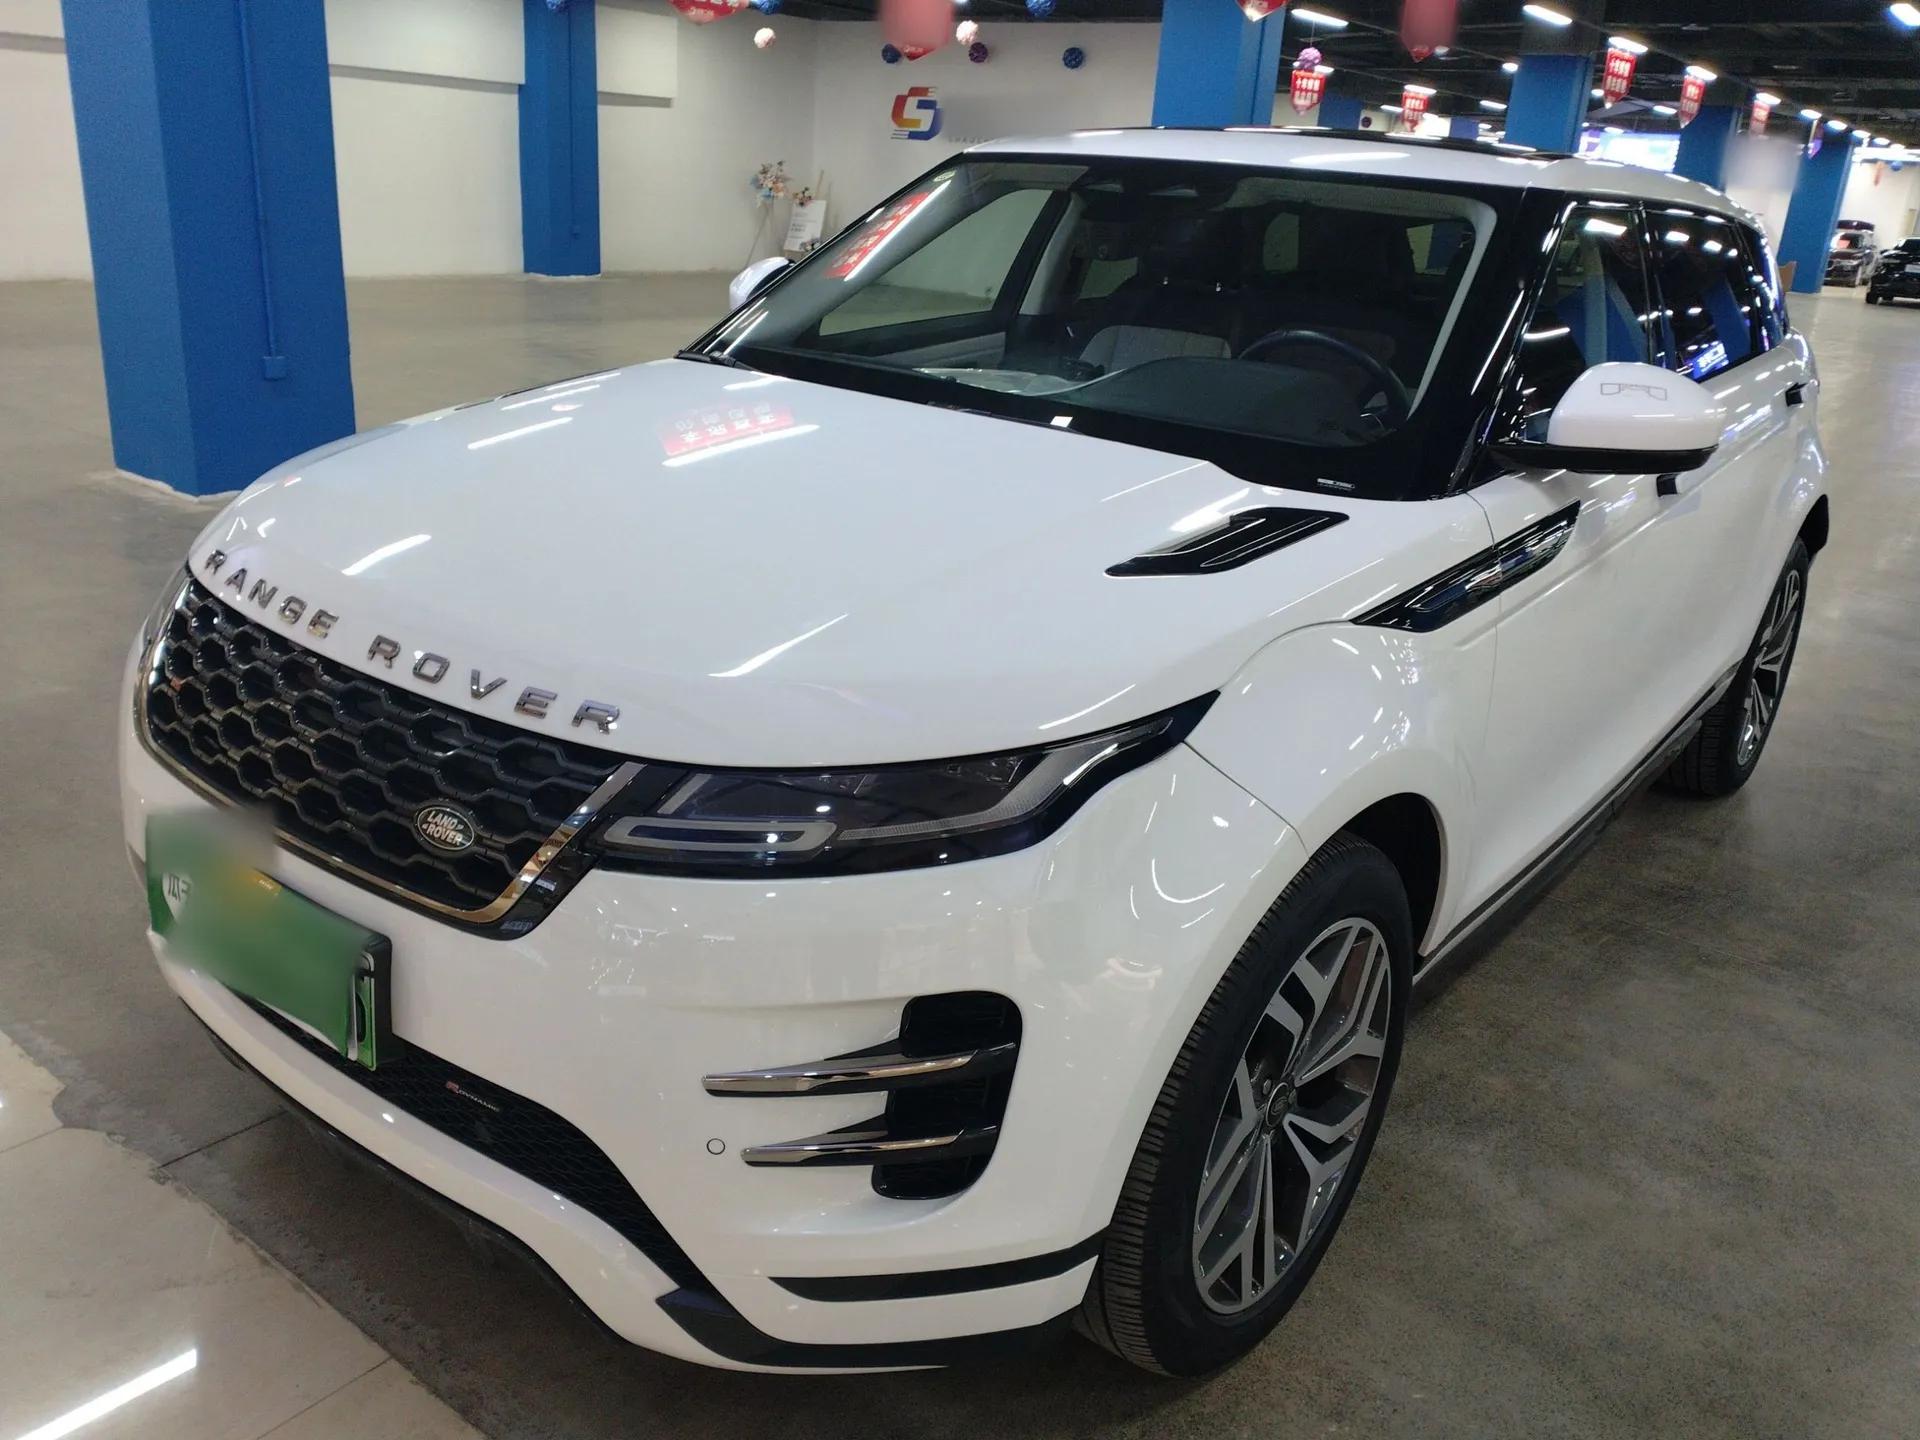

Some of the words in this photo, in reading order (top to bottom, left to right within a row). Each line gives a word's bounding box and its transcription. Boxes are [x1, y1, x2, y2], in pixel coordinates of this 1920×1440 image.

[204, 549, 339, 639] RANGE
[367, 634, 621, 735] ROVER
[427, 811, 458, 830] LAND
[426, 823, 463, 845] ROVER
